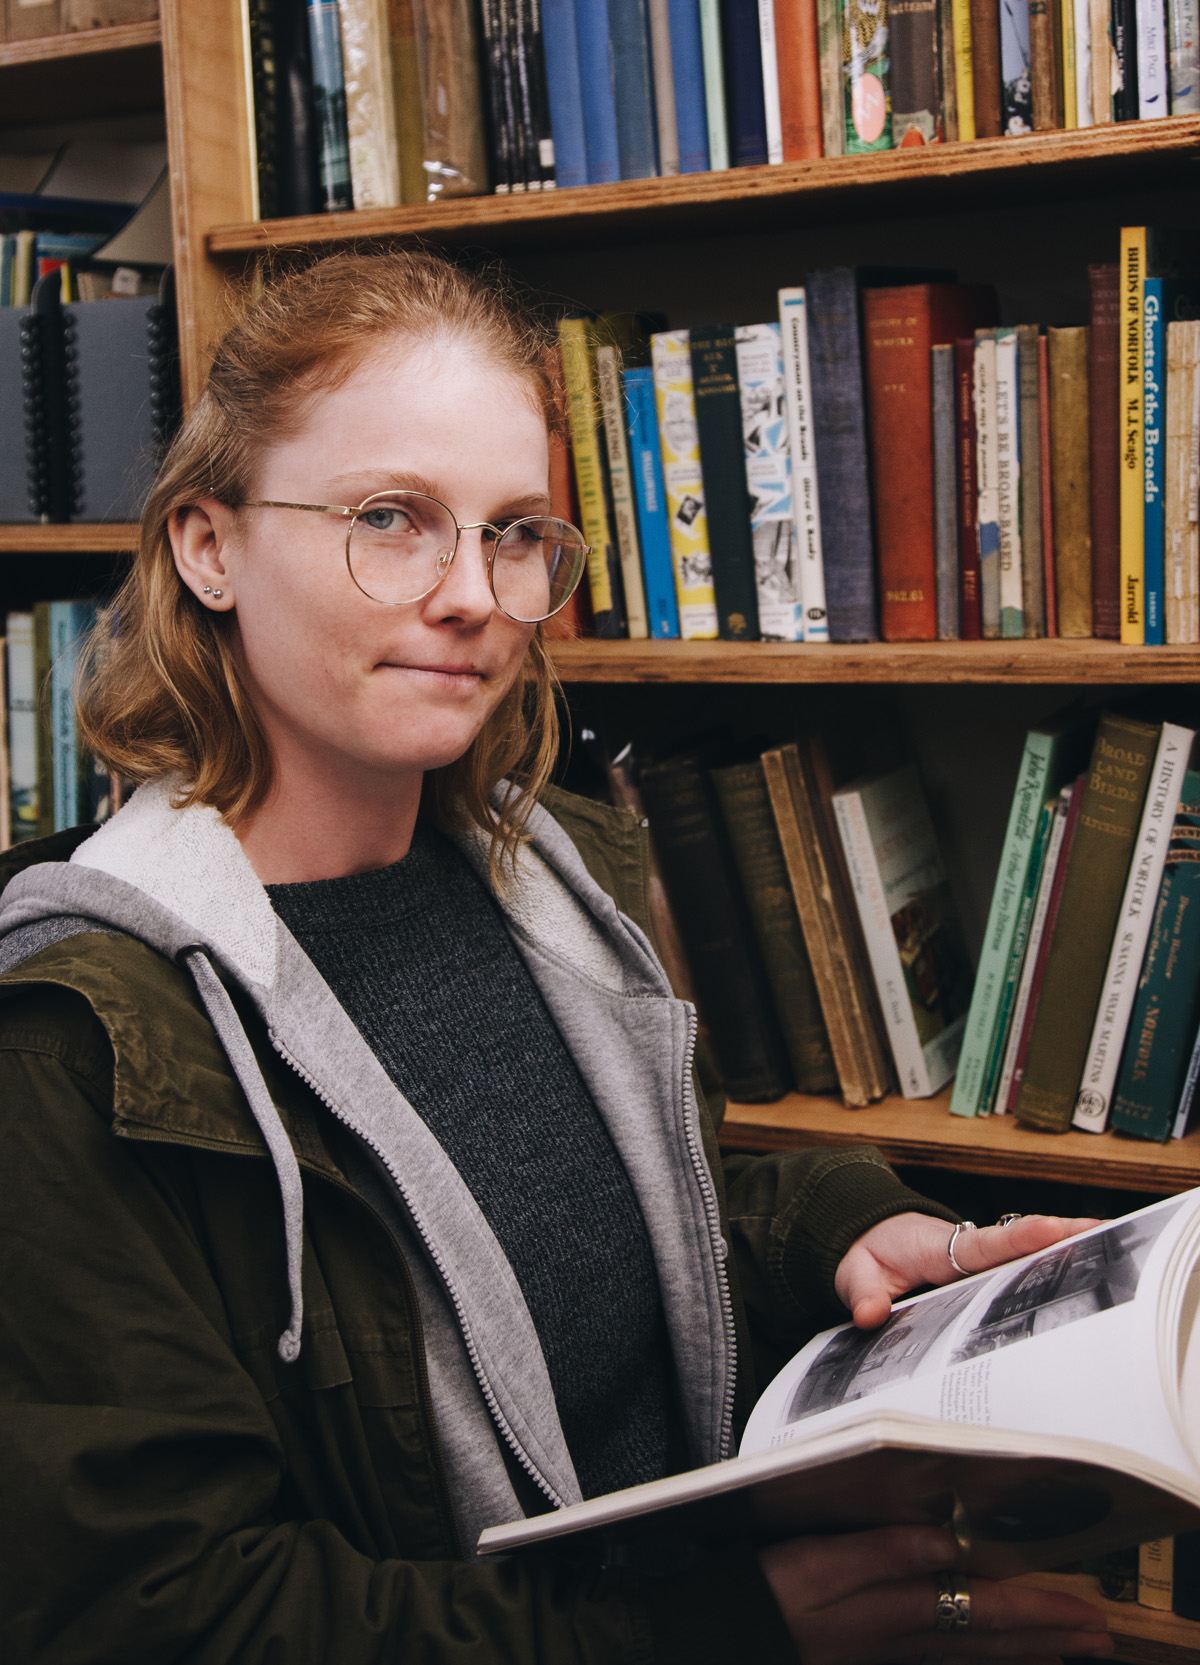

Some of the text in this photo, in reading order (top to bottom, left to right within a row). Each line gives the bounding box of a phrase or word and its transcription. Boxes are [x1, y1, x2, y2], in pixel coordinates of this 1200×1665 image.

[1147, 54, 1158, 78] PAGE
[1126, 246, 1138, 293] BIRDS
[1126, 296, 1138, 315] OF
[1126, 319, 1138, 385] NORFOLK
[787, 316, 804, 386] Countryman
[797, 425, 810, 461] Broads
[1141, 294, 1161, 503] Ghosts of the Broads
[1124, 429, 1138, 469] Seago
[994, 380, 1014, 572] LET'S BE BROAD-BASED
[1126, 574, 1139, 624] Jarrold
[1026, 747, 1046, 780] John
[1096, 760, 1137, 782] LAND
[1099, 737, 1146, 766] BROAD
[1090, 773, 1138, 802] BIRDS
[1087, 741, 1178, 1085] A HISTORY OF NORFOLK SUSANNA WADE MARTINS
[1132, 1005, 1160, 1083] NORFOLK
